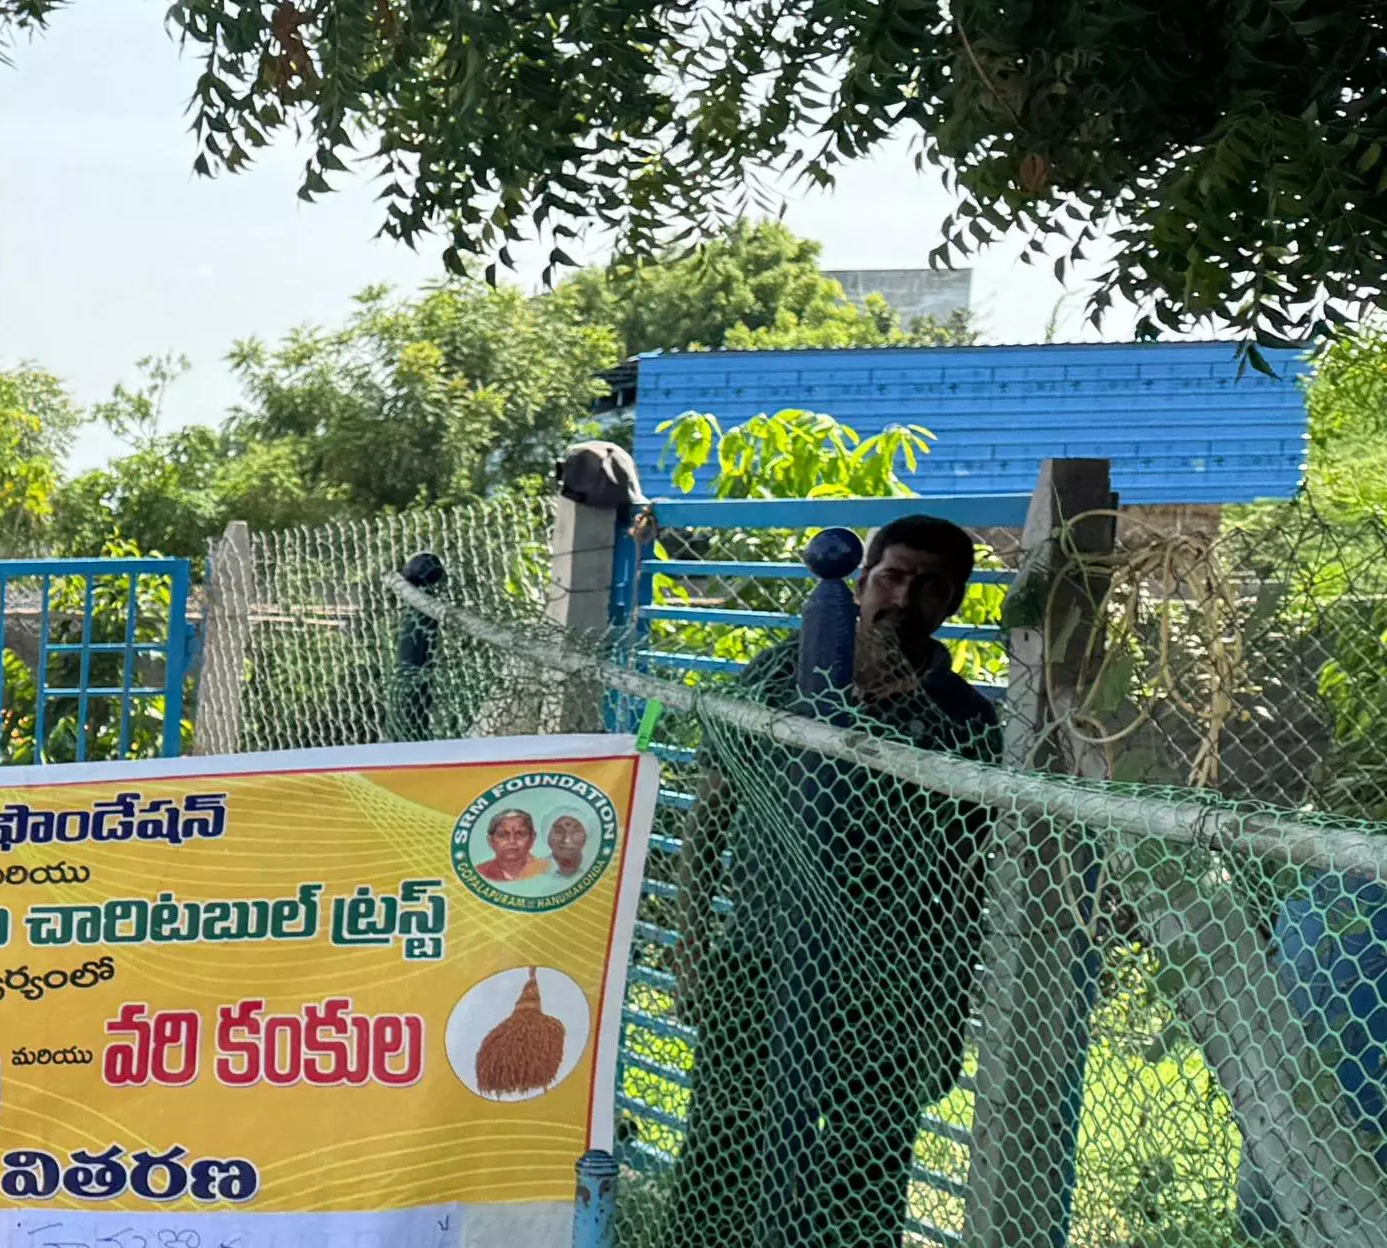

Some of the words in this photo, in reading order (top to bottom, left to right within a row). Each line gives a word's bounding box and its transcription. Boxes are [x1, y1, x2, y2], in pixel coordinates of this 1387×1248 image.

[454, 797, 489, 844] SRM
[491, 774, 615, 840] FOUNDATION
[456, 860, 526, 908] GOPALAPURAM
[27, 884, 323, 948] చారిటబుల్
[331, 879, 447, 960] ట్రస్ట్
[10, 1045, 94, 1066] మరియు
[102, 1003, 201, 1087] వరి
[215, 998, 423, 1088] కంకుల
[0, 1142, 258, 1201] వితరణ
